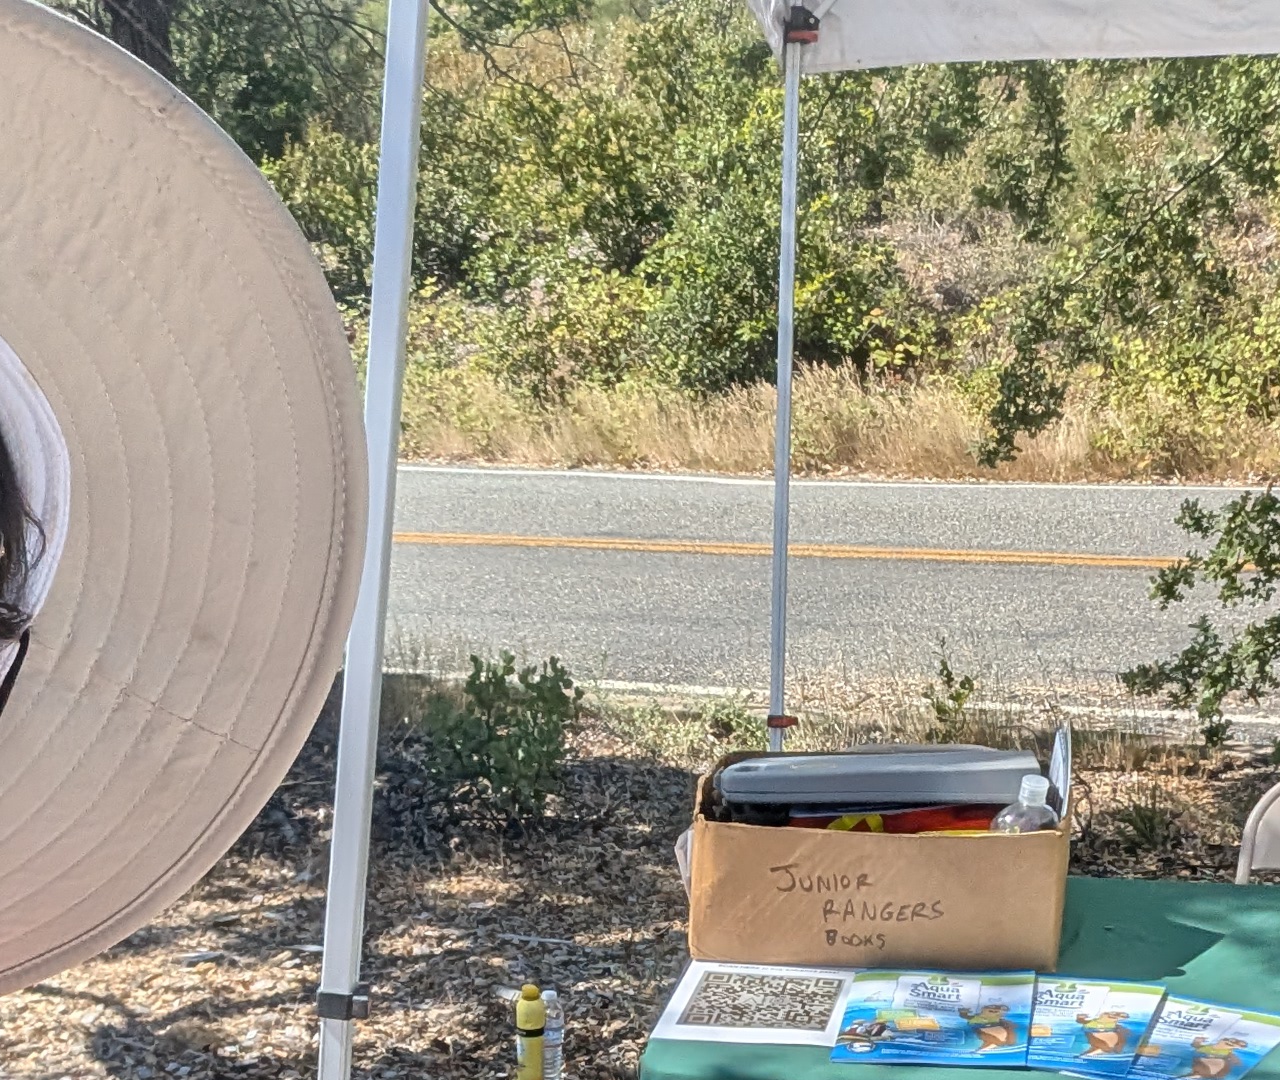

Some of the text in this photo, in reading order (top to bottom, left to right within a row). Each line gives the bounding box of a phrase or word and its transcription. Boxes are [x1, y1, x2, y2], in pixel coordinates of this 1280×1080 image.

[770, 863, 873, 893] JUNIOR
[822, 899, 944, 923] RANGERS
[910, 981, 961, 993] Aqua
[909, 988, 962, 1001] Smart
[1036, 989, 1086, 1001] Aqua
